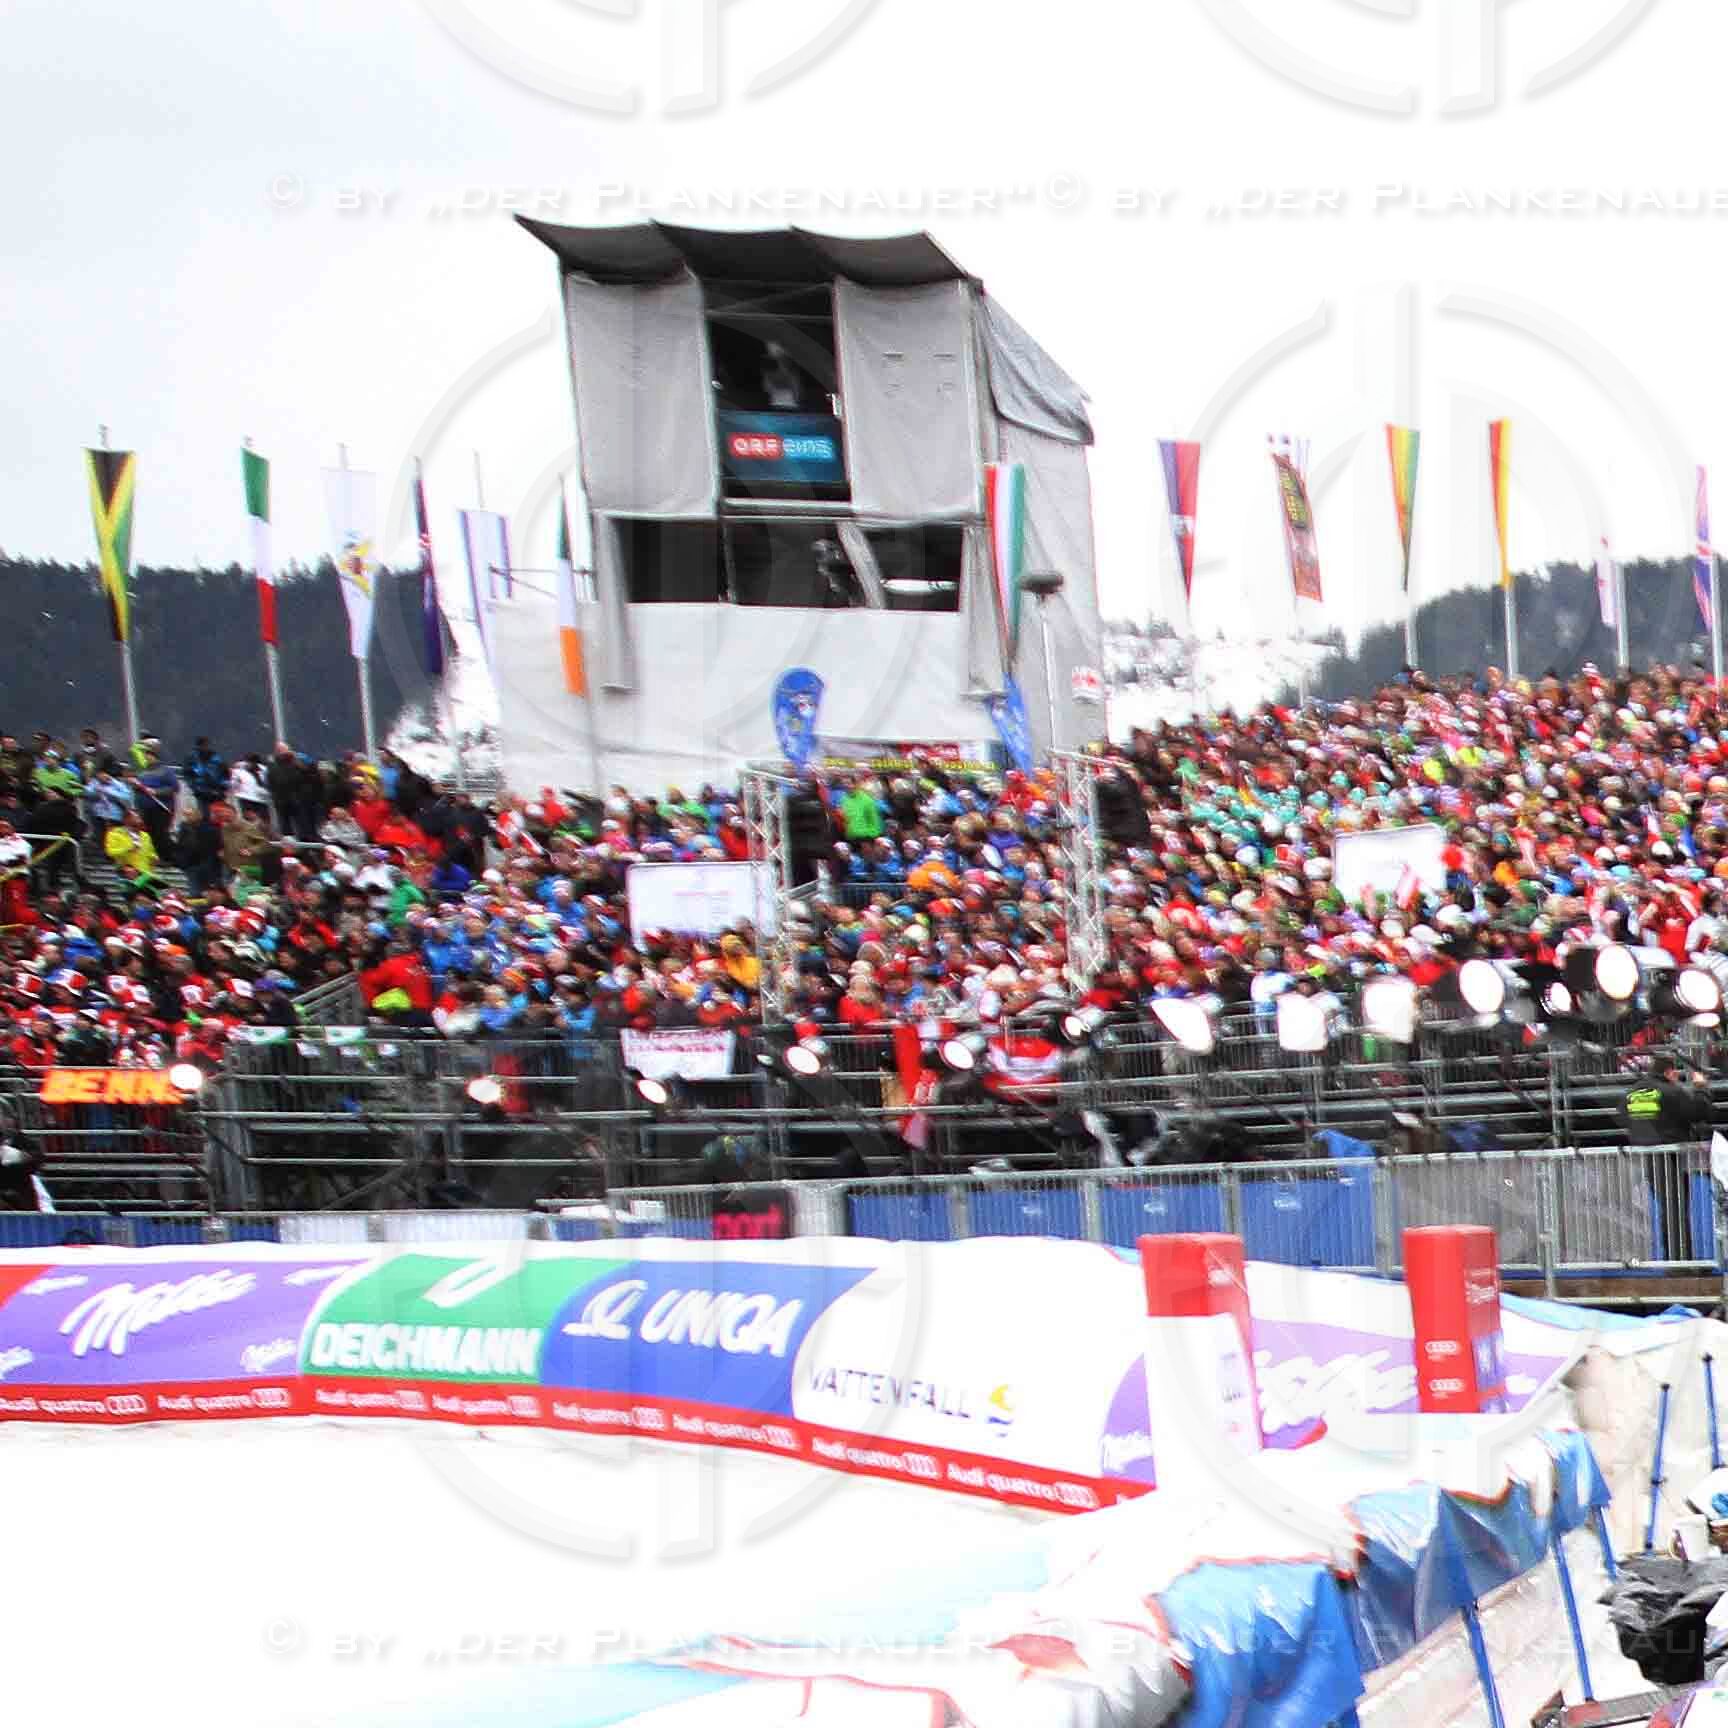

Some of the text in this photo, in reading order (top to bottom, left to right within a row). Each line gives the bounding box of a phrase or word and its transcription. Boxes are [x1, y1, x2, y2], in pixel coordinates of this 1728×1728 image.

[310, 1323, 541, 1374] DEICHMANN
[640, 1289, 801, 1357] UNIQA
[808, 1367, 972, 1419] VATTENFALL
